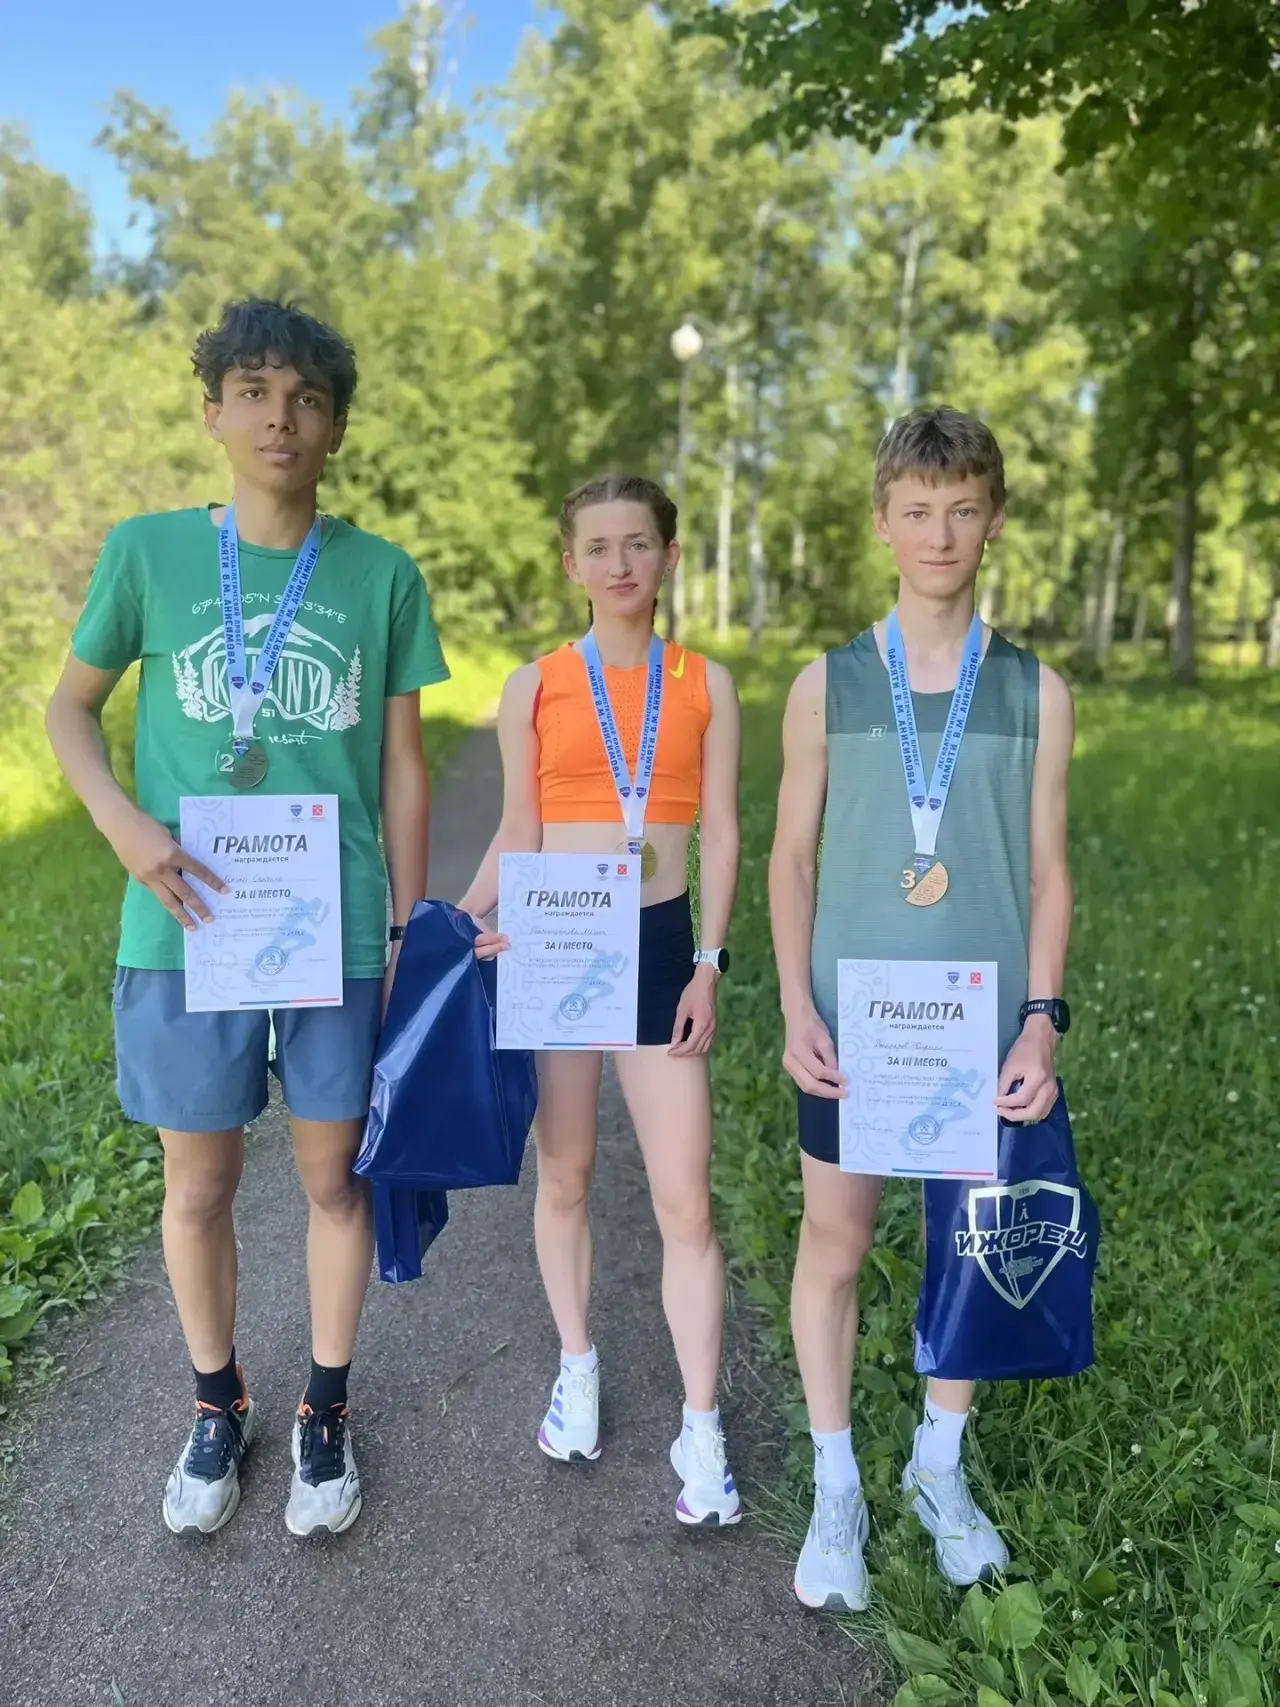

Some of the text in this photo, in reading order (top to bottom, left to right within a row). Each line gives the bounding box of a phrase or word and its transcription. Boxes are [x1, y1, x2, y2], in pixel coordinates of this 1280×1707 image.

[220, 529, 230, 568] ПАМЯТИ
[264, 632, 286, 674] ПАМЯТИ
[291, 547, 319, 605] АНИСИМОВА
[223, 599, 236, 665] АНИСИМОВА
[588, 665, 599, 696] ПАМЯТИ
[601, 721, 621, 778] АНИСИМОВА
[643, 737, 656, 777] ПАМЯТИ
[653, 664, 662, 711] АНИСИМОВА
[888, 648, 900, 689] ПАМЯТИ
[898, 720, 916, 786] АНИСИМОВА
[940, 744, 957, 788] ПАМЯТИ
[960, 652, 979, 714] АНИСИМОВА
[219, 753, 235, 773] 2
[213, 834, 308, 854] ГРАМОТА
[234, 855, 289, 864] награждается
[900, 869, 916, 889] 3
[234, 890, 247, 899] ЗА
[258, 888, 291, 899] МЕСТО
[526, 890, 612, 908] ГРАМОТА
[545, 910, 594, 918] награждается
[544, 941, 556, 950] ЗА
[563, 941, 593, 950] МЕСТО
[868, 1000, 965, 1021] ГРАМОТА
[889, 1023, 945, 1031] награждается
[887, 1056, 900, 1066] ЗА
[913, 1057, 948, 1068] МЕСТО
[955, 1220, 1088, 1259] ИЖОРЕЦ
